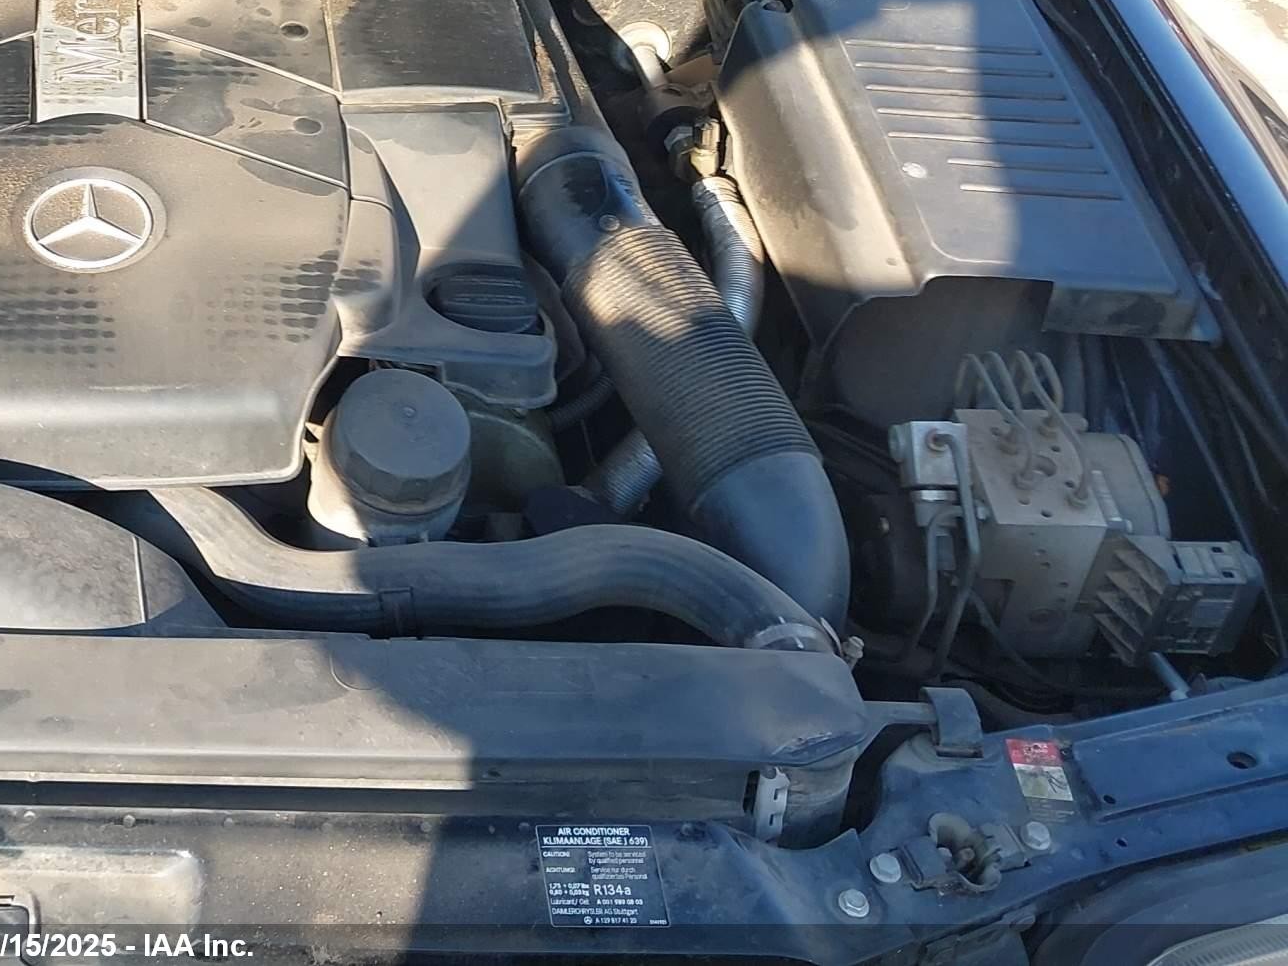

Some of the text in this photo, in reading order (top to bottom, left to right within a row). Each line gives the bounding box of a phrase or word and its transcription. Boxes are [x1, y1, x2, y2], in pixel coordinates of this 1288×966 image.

[557, 827, 630, 836] AIR CONDITIONER
[542, 836, 602, 846] KLIMAANLAGE
[629, 836, 649, 846] 639)
[593, 884, 632, 896] R134a
